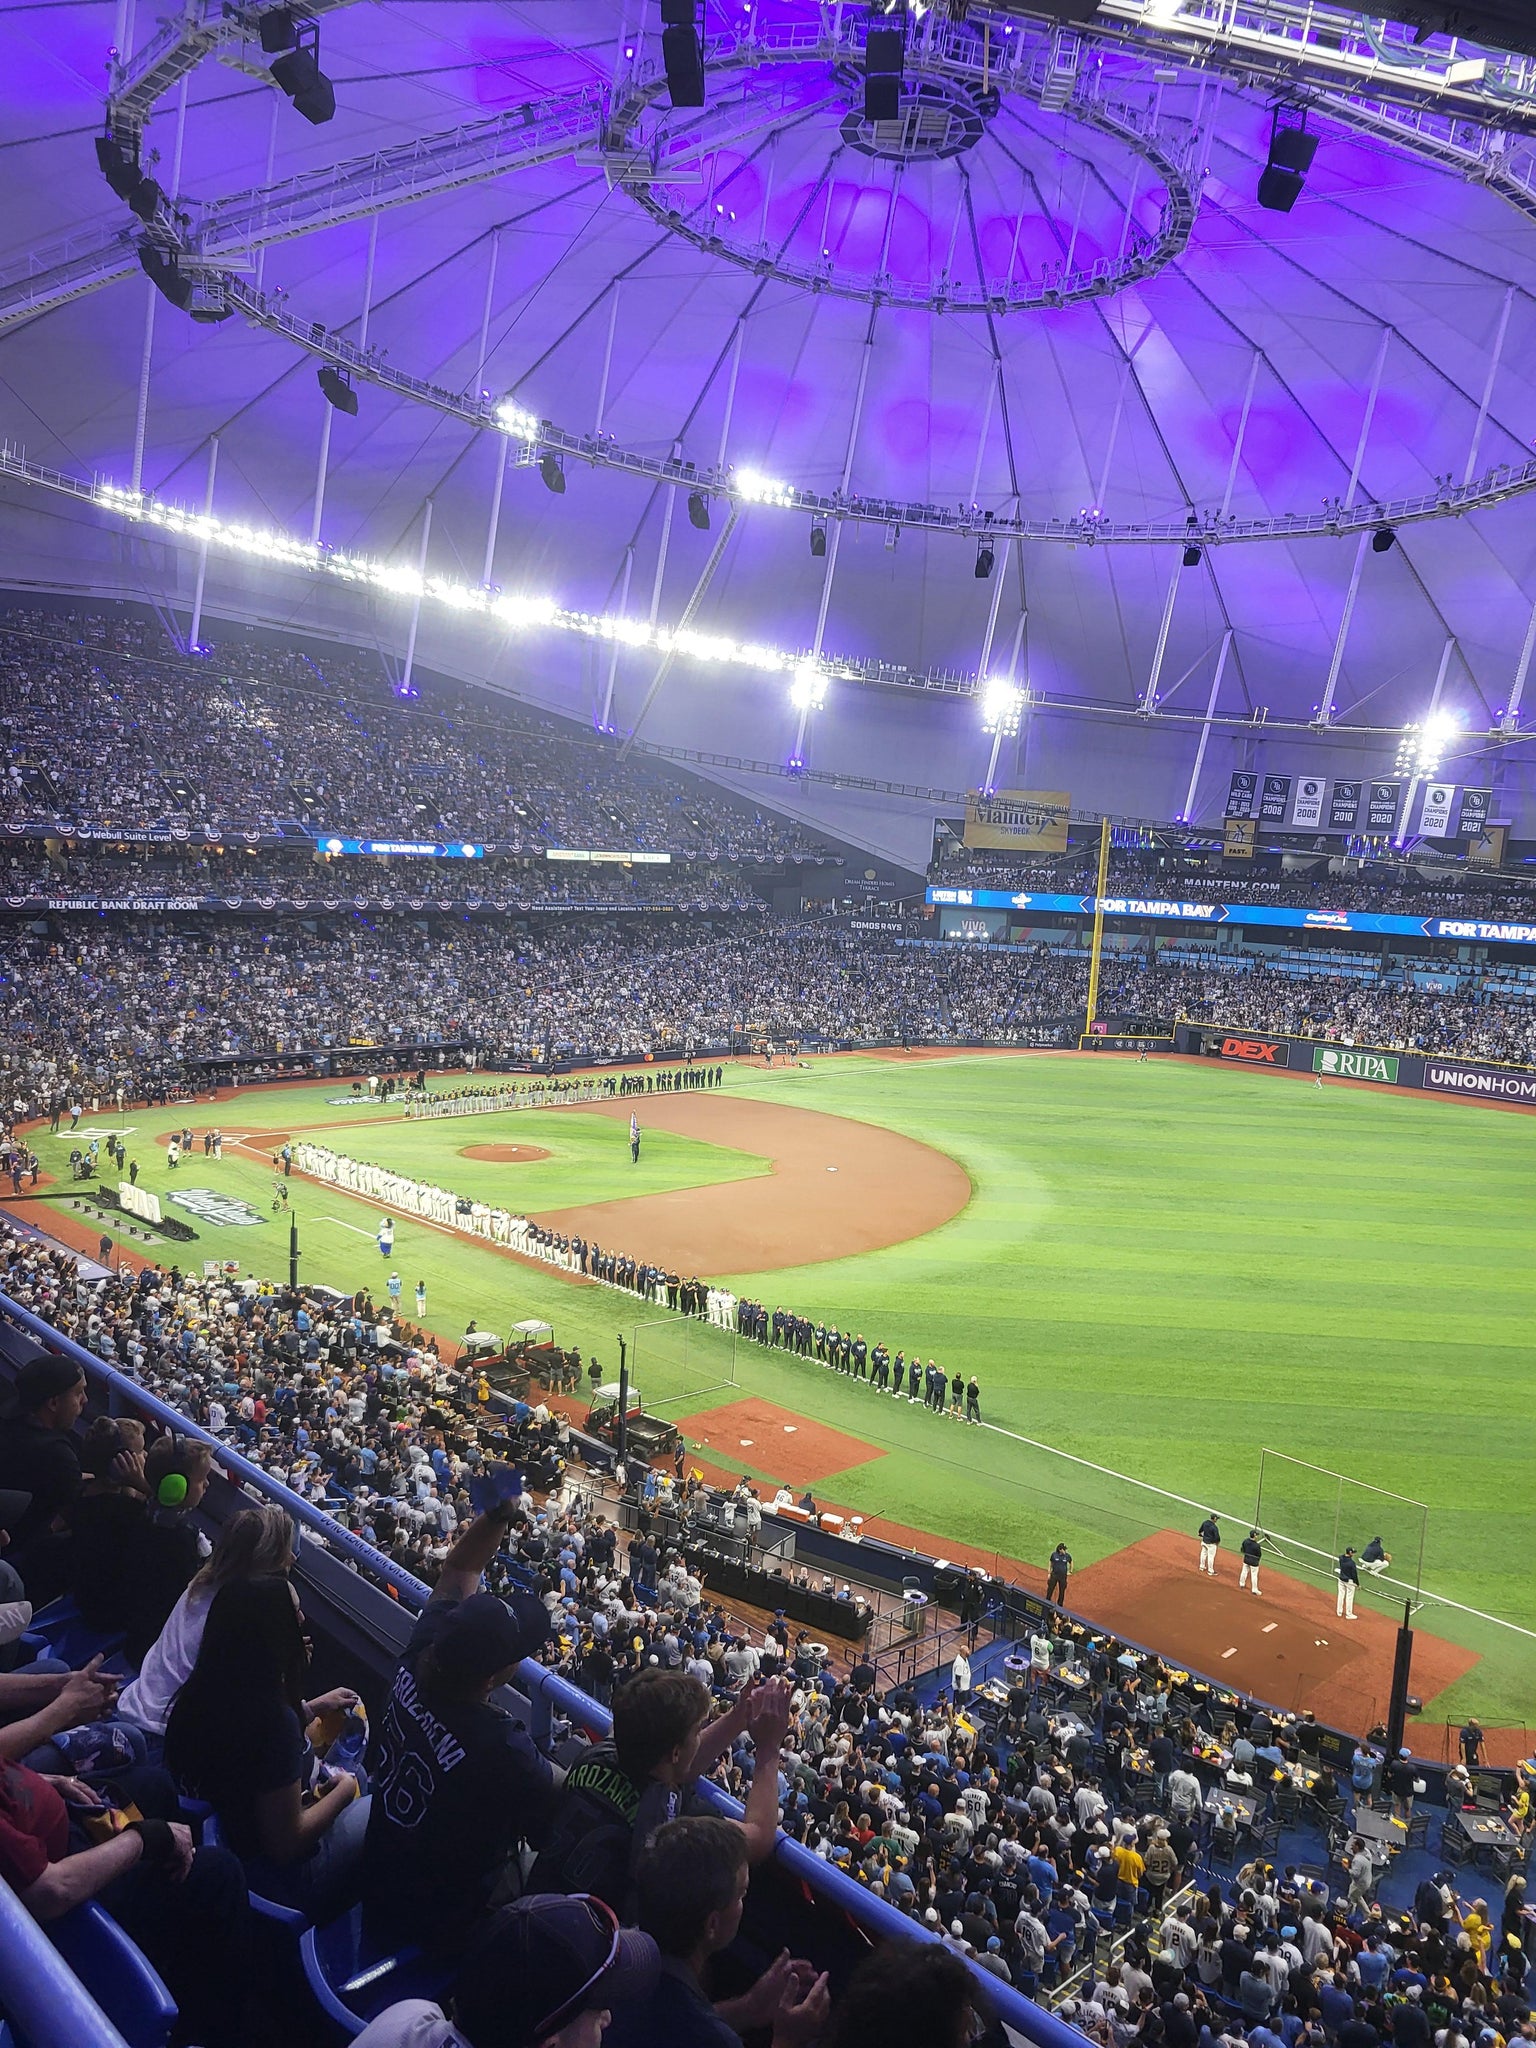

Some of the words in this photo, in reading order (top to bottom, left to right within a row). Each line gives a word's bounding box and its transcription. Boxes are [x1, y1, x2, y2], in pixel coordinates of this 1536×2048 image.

[1262, 805, 1283, 816] 2008
[1297, 808, 1317, 819] 2008
[1334, 811, 1353, 822] 2010
[1424, 807, 1448, 815] CHAMPIONS
[1370, 813, 1392, 823] 2020
[1424, 817, 1444, 828] 2020
[1461, 821, 1481, 833] 2021
[93, 830, 121, 840] Webull
[124, 832, 147, 841] Suite
[149, 833, 172, 842] Level
[48, 900, 99, 909] REPUBLIC
[102, 901, 130, 909] BANK
[133, 901, 165, 909] DRAFT
[167, 901, 198, 910] ROOM
[1127, 901, 1180, 915] TAMPA
[1182, 904, 1215, 918] BAY
[962, 920, 986, 931] VIVA
[1439, 921, 1477, 936] FOR
[1477, 924, 1536, 941] TAMPA
[1221, 1038, 1280, 1062] DEX
[1338, 1054, 1390, 1080] RIPA
[1430, 1068, 1536, 1098] UNIONHOM
[566, 1762, 641, 1827] AROZAREN
[967, 1799, 981, 1812] 60
[1152, 1860, 1169, 1873] 22
[1172, 1932, 1180, 1946] 2
